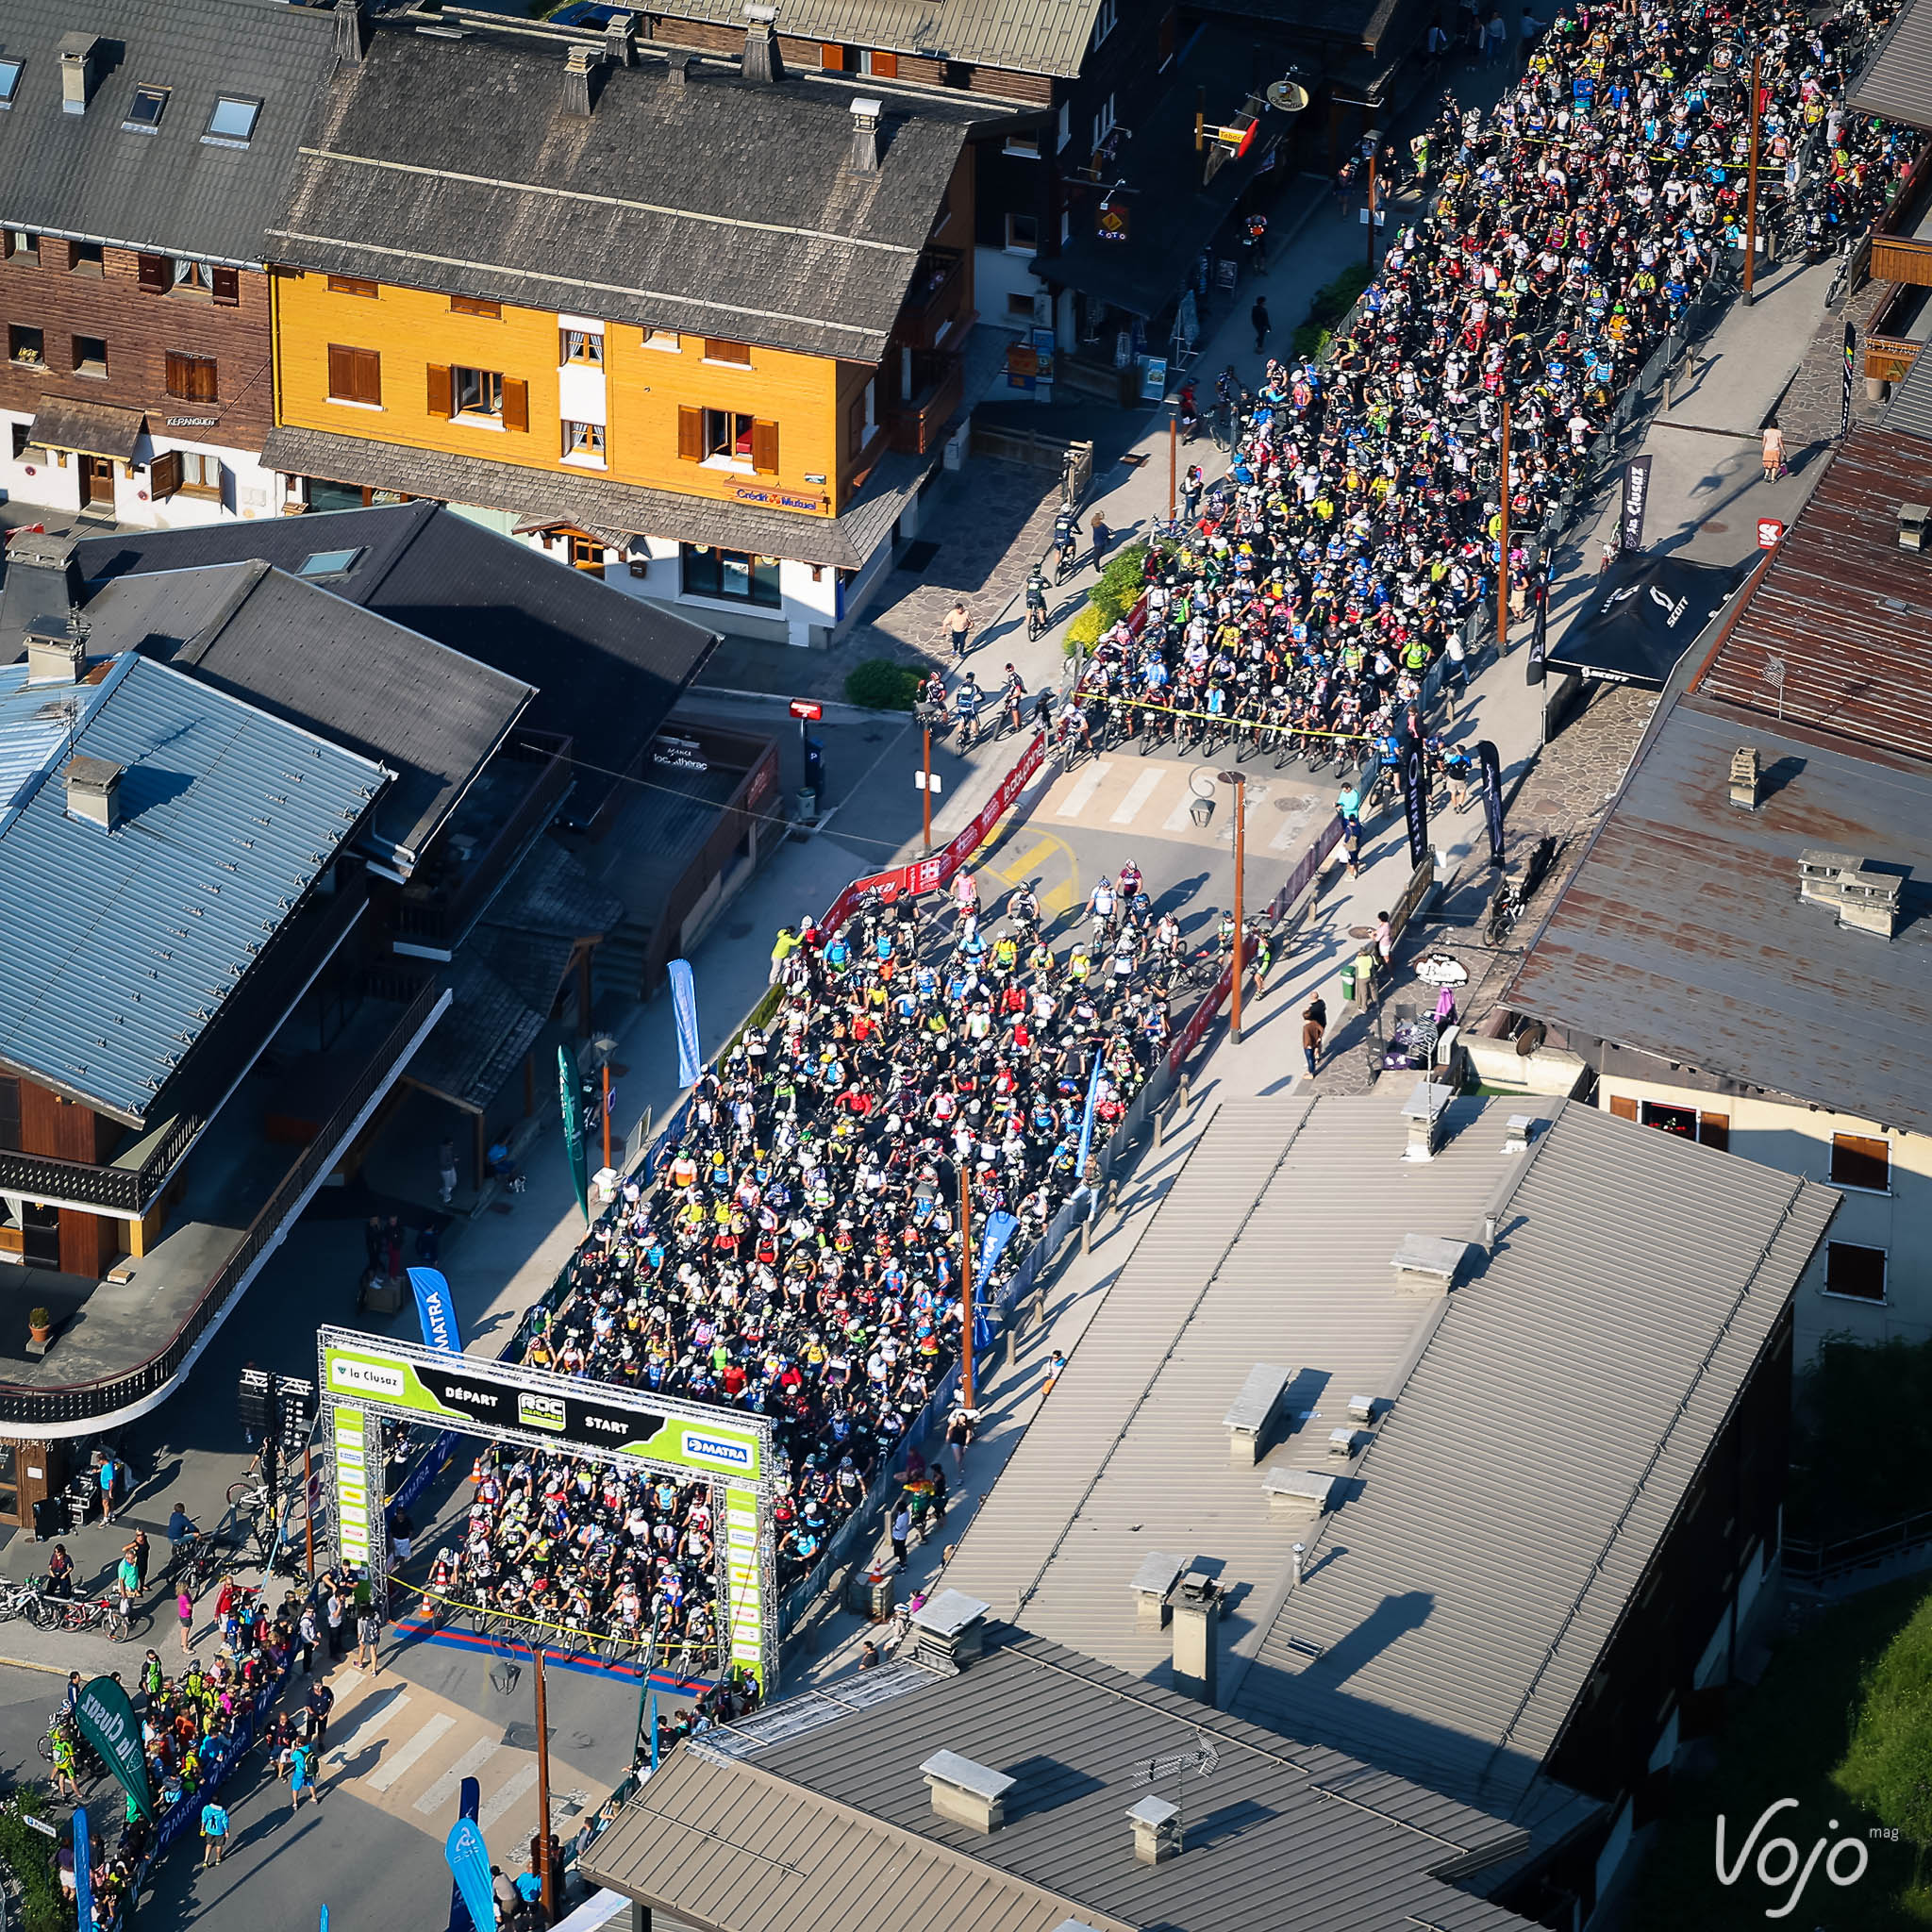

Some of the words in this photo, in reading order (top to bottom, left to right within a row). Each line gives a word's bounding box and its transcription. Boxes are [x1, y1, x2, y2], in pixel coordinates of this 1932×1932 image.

[1220, 131, 1241, 142] Tabac
[1098, 229, 1125, 240] LOTO
[737, 489, 769, 503] Crédit
[781, 496, 817, 510] Mutuel
[1626, 466, 1644, 516] Clusaz
[1666, 595, 1689, 628] SCOTT
[425, 1291, 450, 1351] MATRA
[350, 1368, 360, 1379] la
[364, 1371, 397, 1387] Clusaz
[445, 1386, 498, 1407] DÉPART
[521, 1395, 563, 1415] ROC
[584, 1416, 628, 1434] START
[702, 1442, 746, 1460] MATRA
[170, 1789, 202, 1830] MATRA
